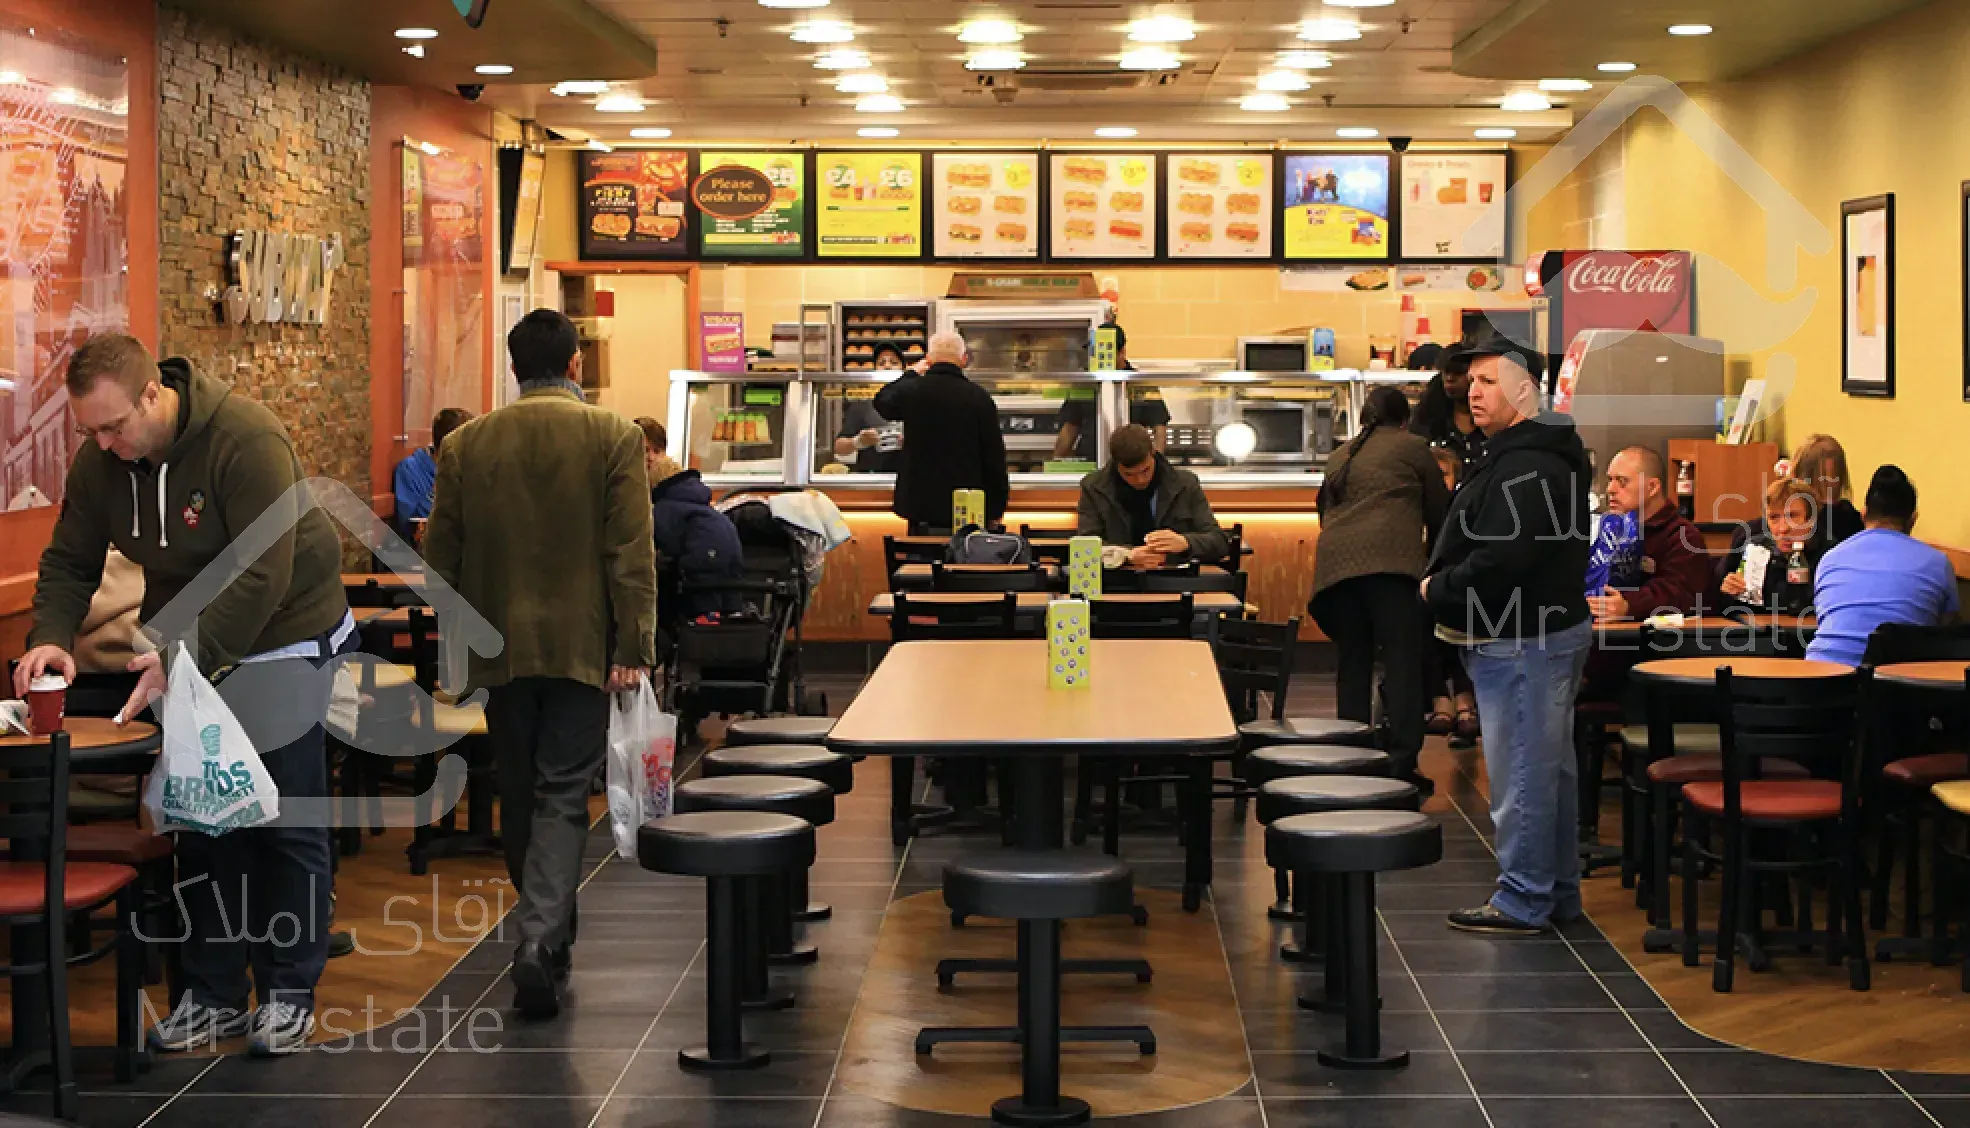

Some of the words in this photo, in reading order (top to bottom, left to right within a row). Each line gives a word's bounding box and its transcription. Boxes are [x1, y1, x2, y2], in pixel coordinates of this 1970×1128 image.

[711, 178, 754, 189] Please
[700, 191, 734, 202] order
[737, 191, 766, 202] here
